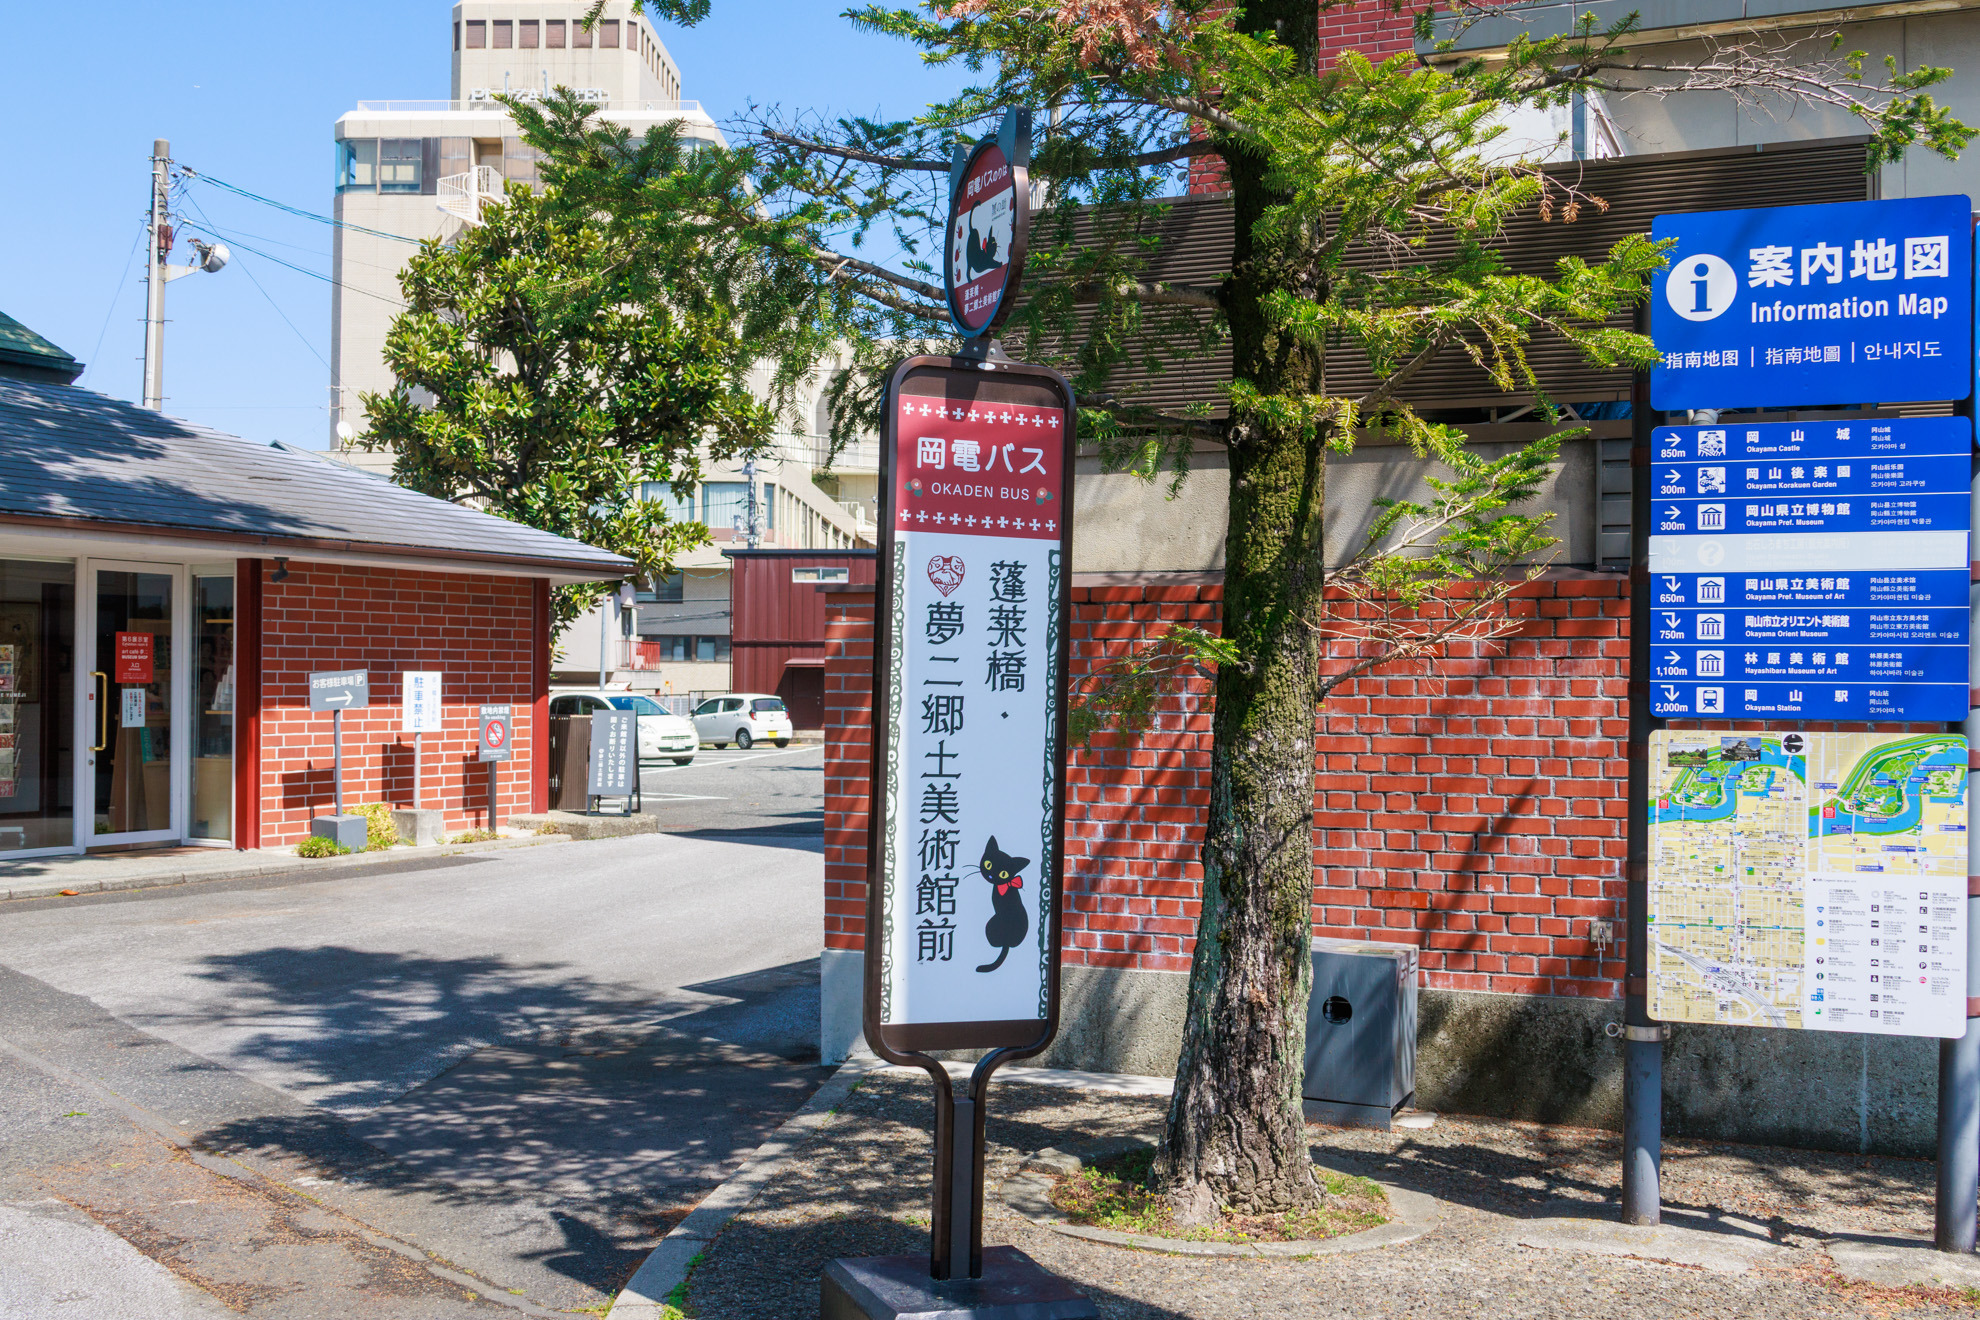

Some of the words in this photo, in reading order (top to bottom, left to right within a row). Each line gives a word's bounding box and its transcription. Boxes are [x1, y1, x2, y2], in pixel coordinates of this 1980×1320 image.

[1748, 235, 1949, 288] 案内地図
[1751, 297, 1889, 323] Information
[1899, 294, 1948, 319] Map
[1765, 346, 1841, 366] 指南地圖
[1864, 341, 1943, 361] 안내지도
[1666, 350, 1739, 370] 指南地图
[1746, 427, 1850, 443] 岡山城
[917, 436, 1046, 475] 岡電バス
[1660, 449, 1686, 458] 850m
[1746, 465, 1851, 480] 岡山後楽園
[931, 482, 993, 498] OKADEN
[1001, 487, 1030, 500] BUS
[1660, 485, 1686, 494] 300m
[1746, 503, 1851, 517] 岡山県立博物館
[1660, 522, 1685, 531] 300m
[1745, 578, 1850, 590] 岡山県立美術館
[1660, 594, 1685, 603] 650m
[1745, 615, 1850, 627] 岡山市立オリエント美術館
[1660, 630, 1685, 639] 750m
[1745, 630, 1776, 638] Okayama
[1745, 652, 1849, 665] 林原美術館
[1656, 667, 1687, 677] 1,100m
[1745, 667, 1786, 675] Hayashibara
[1745, 689, 1848, 702] 岡山駅
[414, 677, 424, 728] 駐車禁止
[1655, 703, 1688, 713] 2,000m
[1745, 704, 1776, 712] Okayama
[618, 717, 628, 787] ご来館者以外の駐車は
[916, 601, 965, 961] 夢二郷土美術館前
